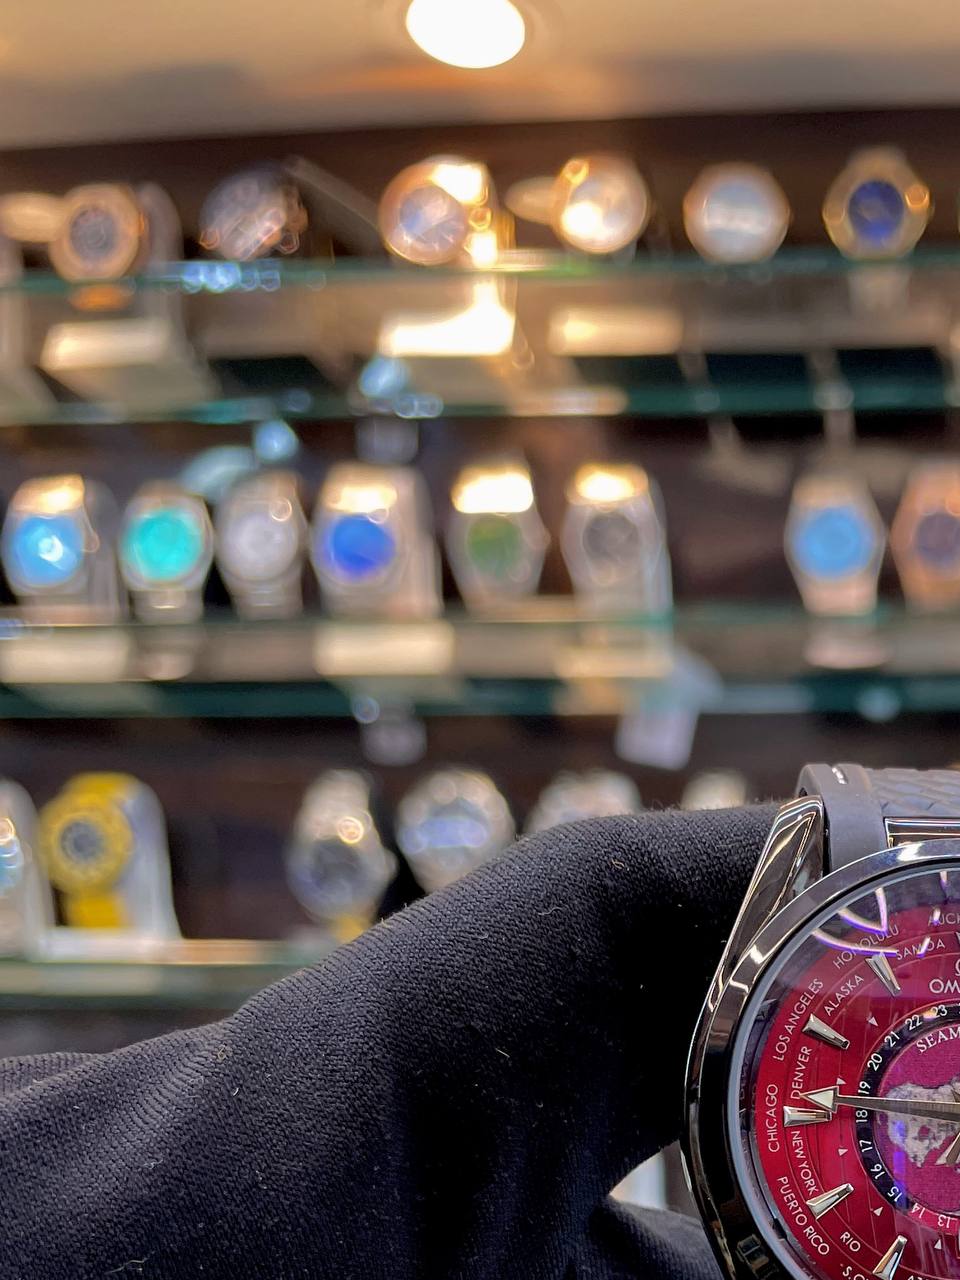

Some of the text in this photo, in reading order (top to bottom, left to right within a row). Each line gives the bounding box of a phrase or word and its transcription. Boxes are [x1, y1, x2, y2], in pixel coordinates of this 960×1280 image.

[823, 974, 865, 1017] ALASKA
[772, 978, 824, 1061] LOS ANGELES
[932, 1004, 948, 1018] 23
[904, 1013, 923, 1031] 22
[884, 1031, 901, 1047] 21
[867, 1052, 883, 1072] 20
[790, 1046, 812, 1100] DENVER
[857, 1080, 871, 1096] 19
[765, 1084, 780, 1153] CHICAGO
[855, 1109, 868, 1123] 18
[859, 1139, 873, 1153] 17
[790, 1130, 819, 1195] NEW YORK
[870, 1163, 886, 1180] 16
[887, 1186, 903, 1202] 15
[777, 1176, 830, 1255] PUERTO RICO
[911, 1202, 926, 1218] 14
[937, 1214, 952, 1228] 13
[840, 1231, 861, 1252] RIO
